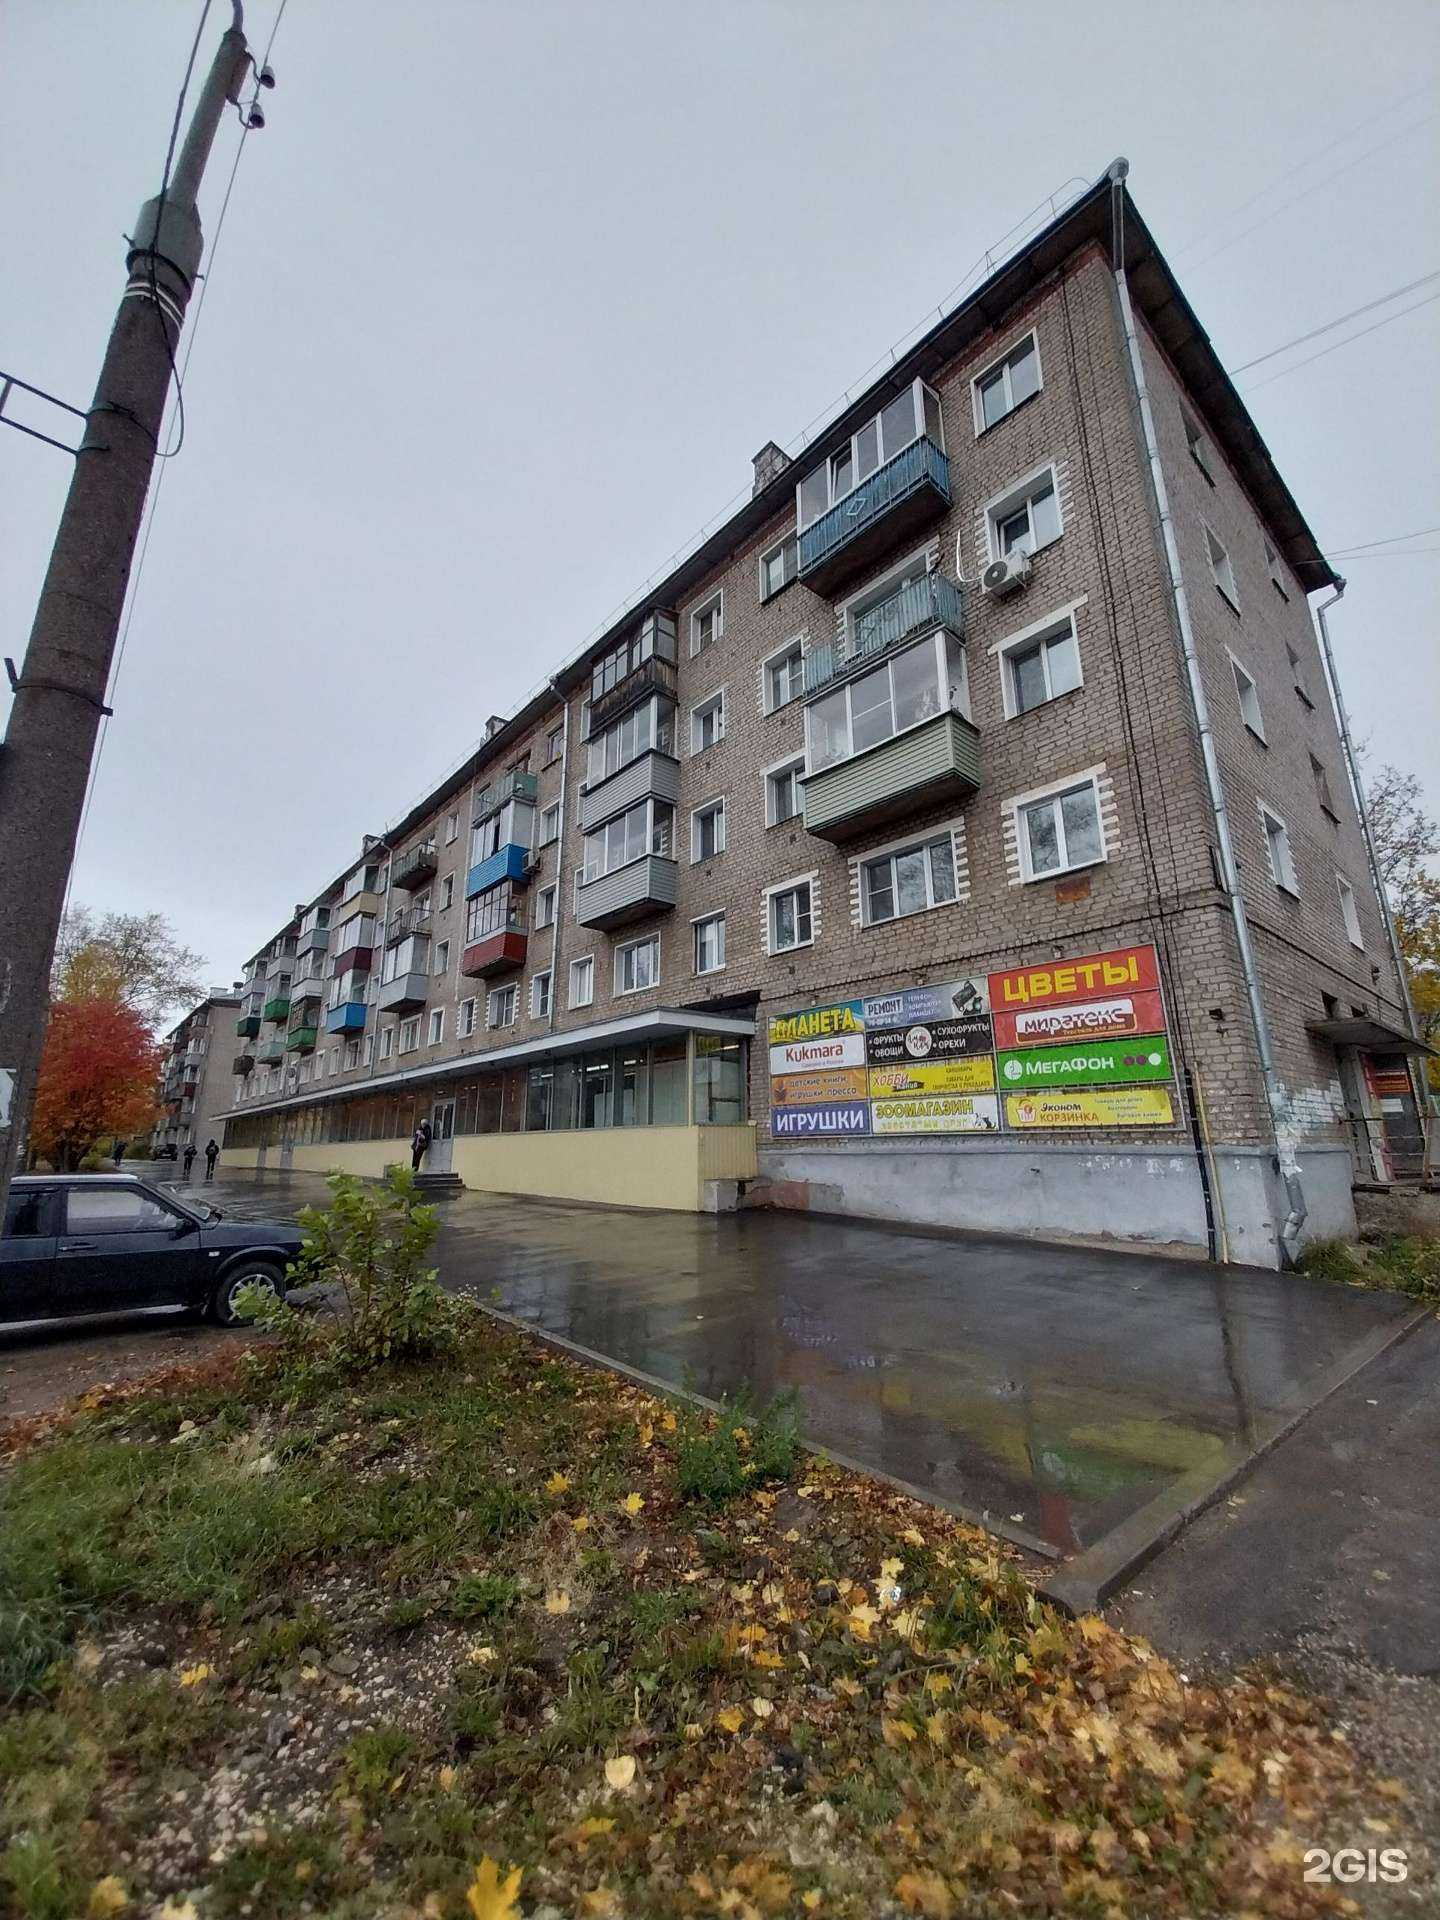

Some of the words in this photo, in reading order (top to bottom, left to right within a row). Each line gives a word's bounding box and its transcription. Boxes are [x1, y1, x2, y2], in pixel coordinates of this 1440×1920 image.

[1004, 957, 1138, 1002] ЦВЕТЫ
[868, 1000, 901, 1015] РЕМОНТ
[776, 1008, 855, 1039] ПЛАНЕТА
[1025, 1008, 1125, 1034] миратекс
[938, 1023, 990, 1035] СУХОФРУКТЫ
[874, 1034, 904, 1045] ФРУКТЫ
[939, 1039, 966, 1049] ОРЕХИ
[786, 1045, 843, 1062] Kukmara
[875, 1046, 904, 1057] ОВОЩИ
[874, 1073, 909, 1087] ХОББИ
[875, 1099, 975, 1119] ЗООМАГАЗИН
[1040, 1103, 1081, 1111] Эконом
[777, 1110, 864, 1131] ИГРУШКИ
[1040, 1112, 1098, 1123] КОРЗИНКА
